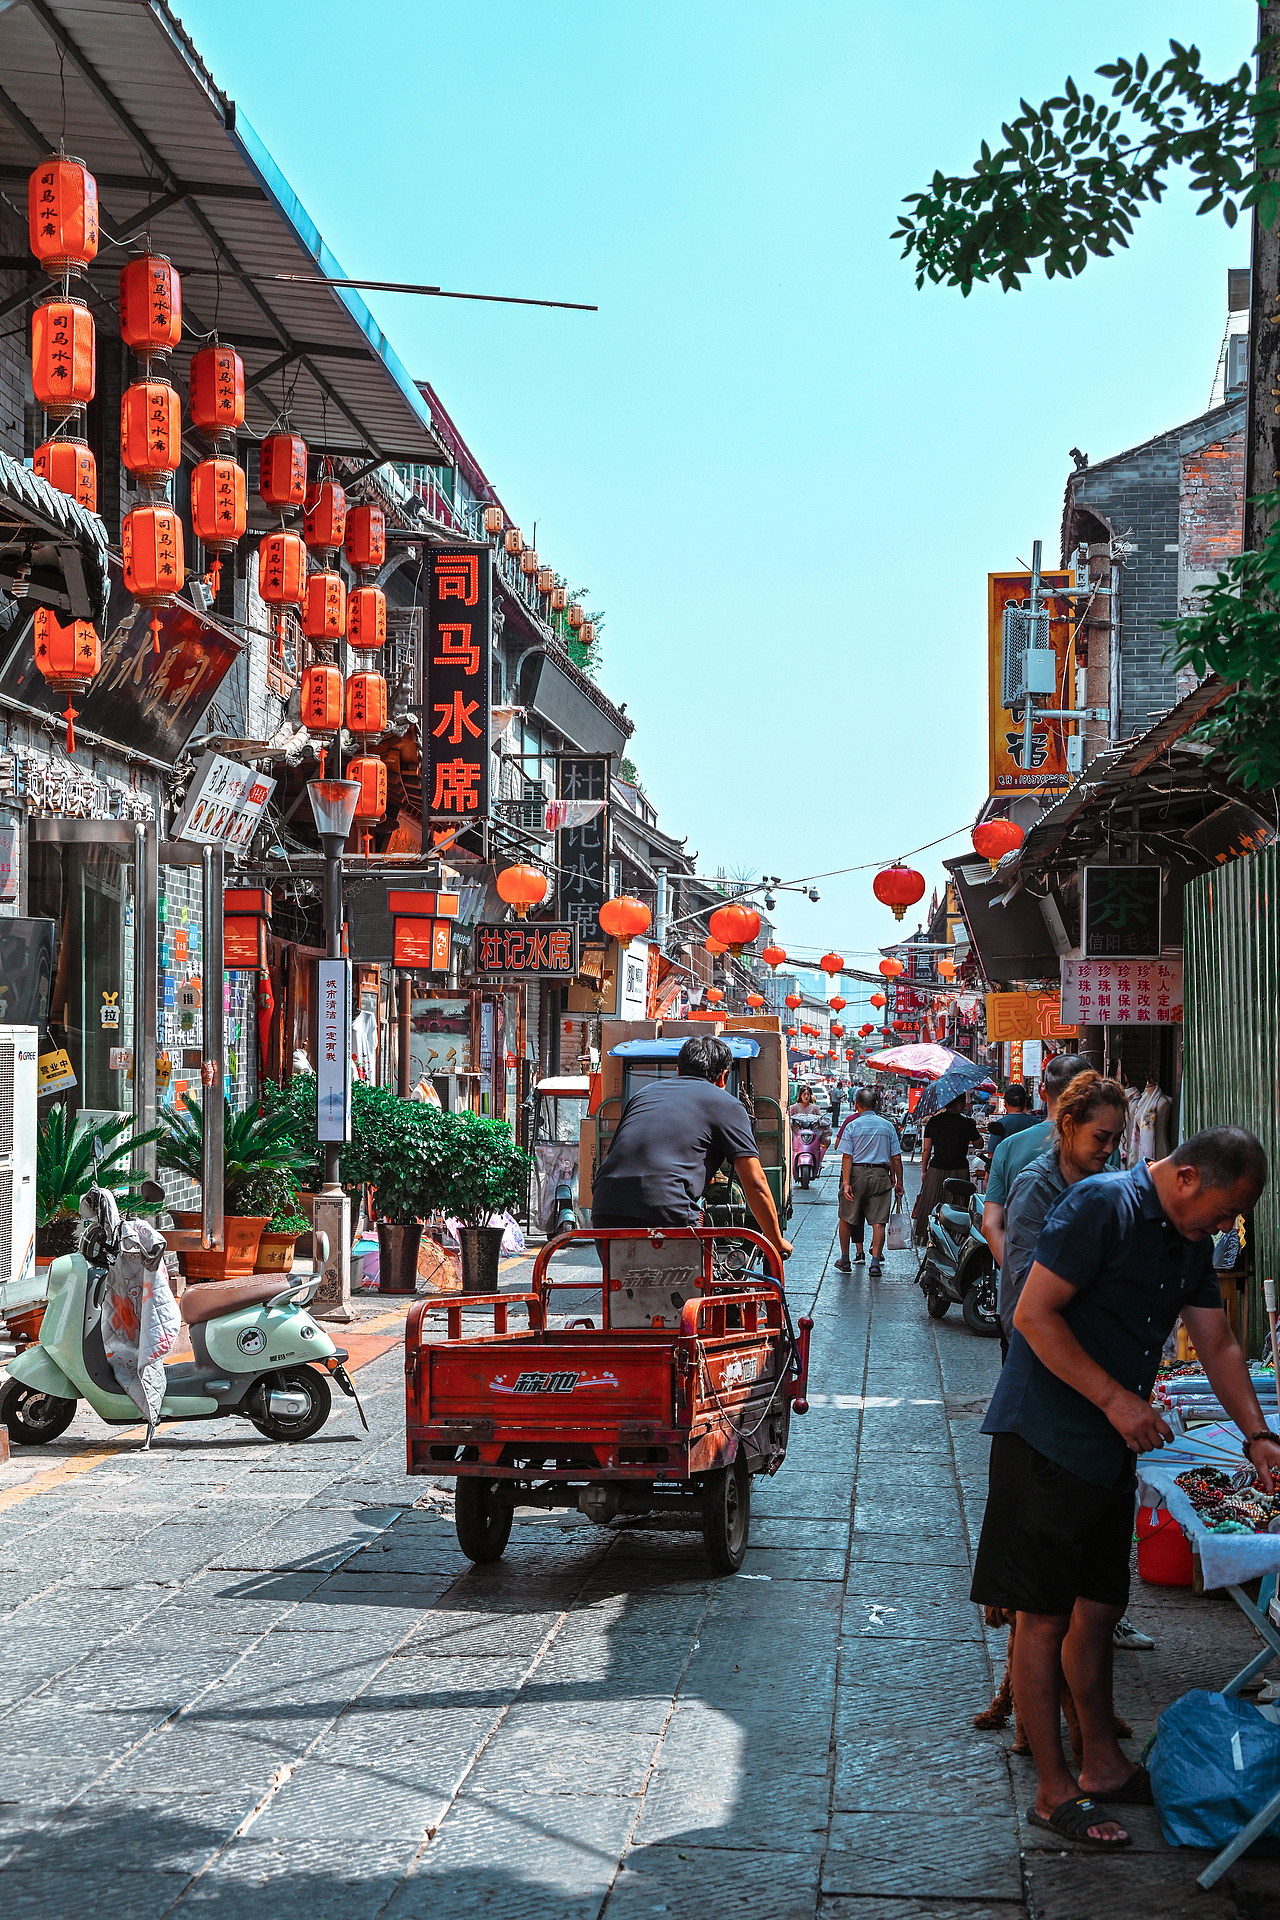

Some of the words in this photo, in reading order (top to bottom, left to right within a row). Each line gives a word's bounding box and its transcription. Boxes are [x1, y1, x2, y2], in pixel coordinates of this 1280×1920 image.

[40, 173, 58, 237] 司马水席
[153, 269, 169, 327] 司马水席
[51, 315, 71, 380] 司马水席
[219, 359, 233, 410] 司马水席
[151, 395, 168, 452] 司马水席
[218, 470, 234, 522] 司马水席
[158, 519, 174, 576] 司马水席
[269, 542, 282, 588] 司马水席
[312, 675, 325, 717] 司马水席
[353, 681, 365, 720] 司马水席
[432, 554, 483, 813] 司马水席
[1088, 869, 1158, 929] 茶
[480, 929, 571, 970] 杜记水席
[1088, 932, 1157, 951] 信阳毛尖
[104, 1009, 117, 1022] 拉
[993, 994, 1077, 1037] 民宿
[1078, 964, 1092, 1022] 珍珠加工
[1097, 964, 1112, 1022] 珍珠制作
[1117, 964, 1132, 1022] 珍珠保养
[1137, 964, 1151, 1022] 珍珠改款
[1156, 964, 1171, 1022] 私人定制
[23, 1051, 36, 1061] GREE
[40, 1059, 69, 1076] 营业中
[117, 1052, 130, 1063] 拉
